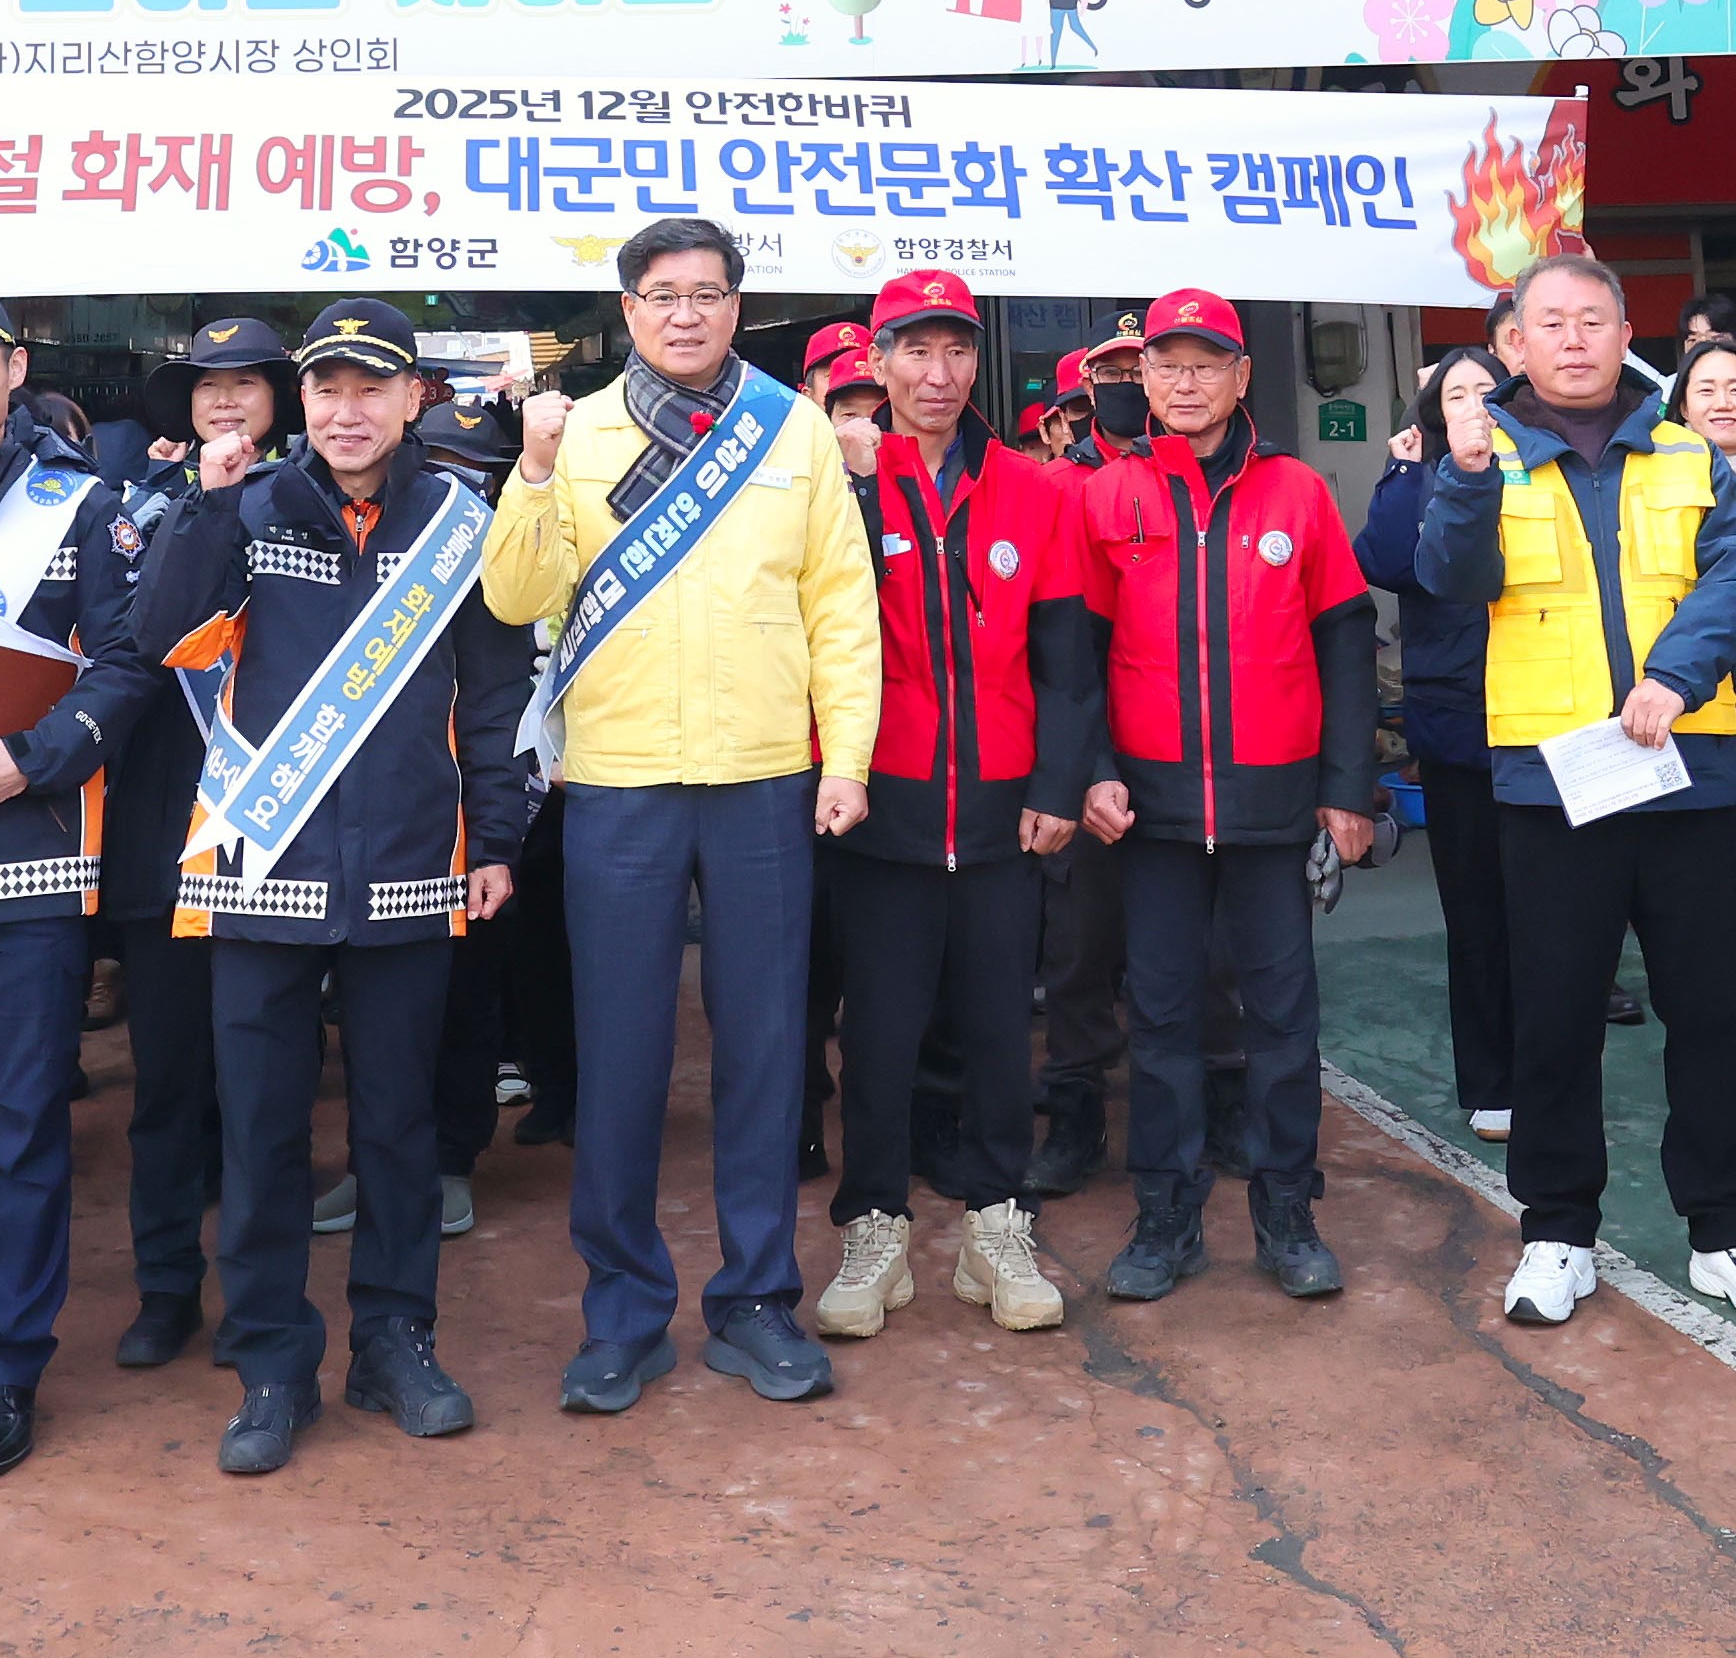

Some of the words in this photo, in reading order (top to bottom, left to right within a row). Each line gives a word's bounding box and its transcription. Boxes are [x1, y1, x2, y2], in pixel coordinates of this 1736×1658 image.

[293, 34, 399, 74] 상인회
[393, 88, 561, 123] 2025년
[579, 87, 671, 127] 12월
[686, 89, 913, 129] 안전한바퀴
[61, 132, 234, 213] 화재
[257, 133, 441, 218] 예방,
[465, 136, 698, 218] 대군민
[716, 136, 1027, 220] 안전문화
[1044, 141, 1195, 224] 확산
[1210, 148, 1418, 232] 캠페인
[388, 237, 499, 270] 함양군
[893, 237, 1015, 262] 함양경찰서
[978, 268, 1016, 277] STATION
[1329, 420, 1355, 437] 2-1
[431, 499, 490, 586] 겨울철
[618, 490, 704, 582] 안전한
[341, 582, 437, 702] 화재예방
[74, 709, 104, 744] GORE-TEX
[243, 702, 349, 832] 함께해요
